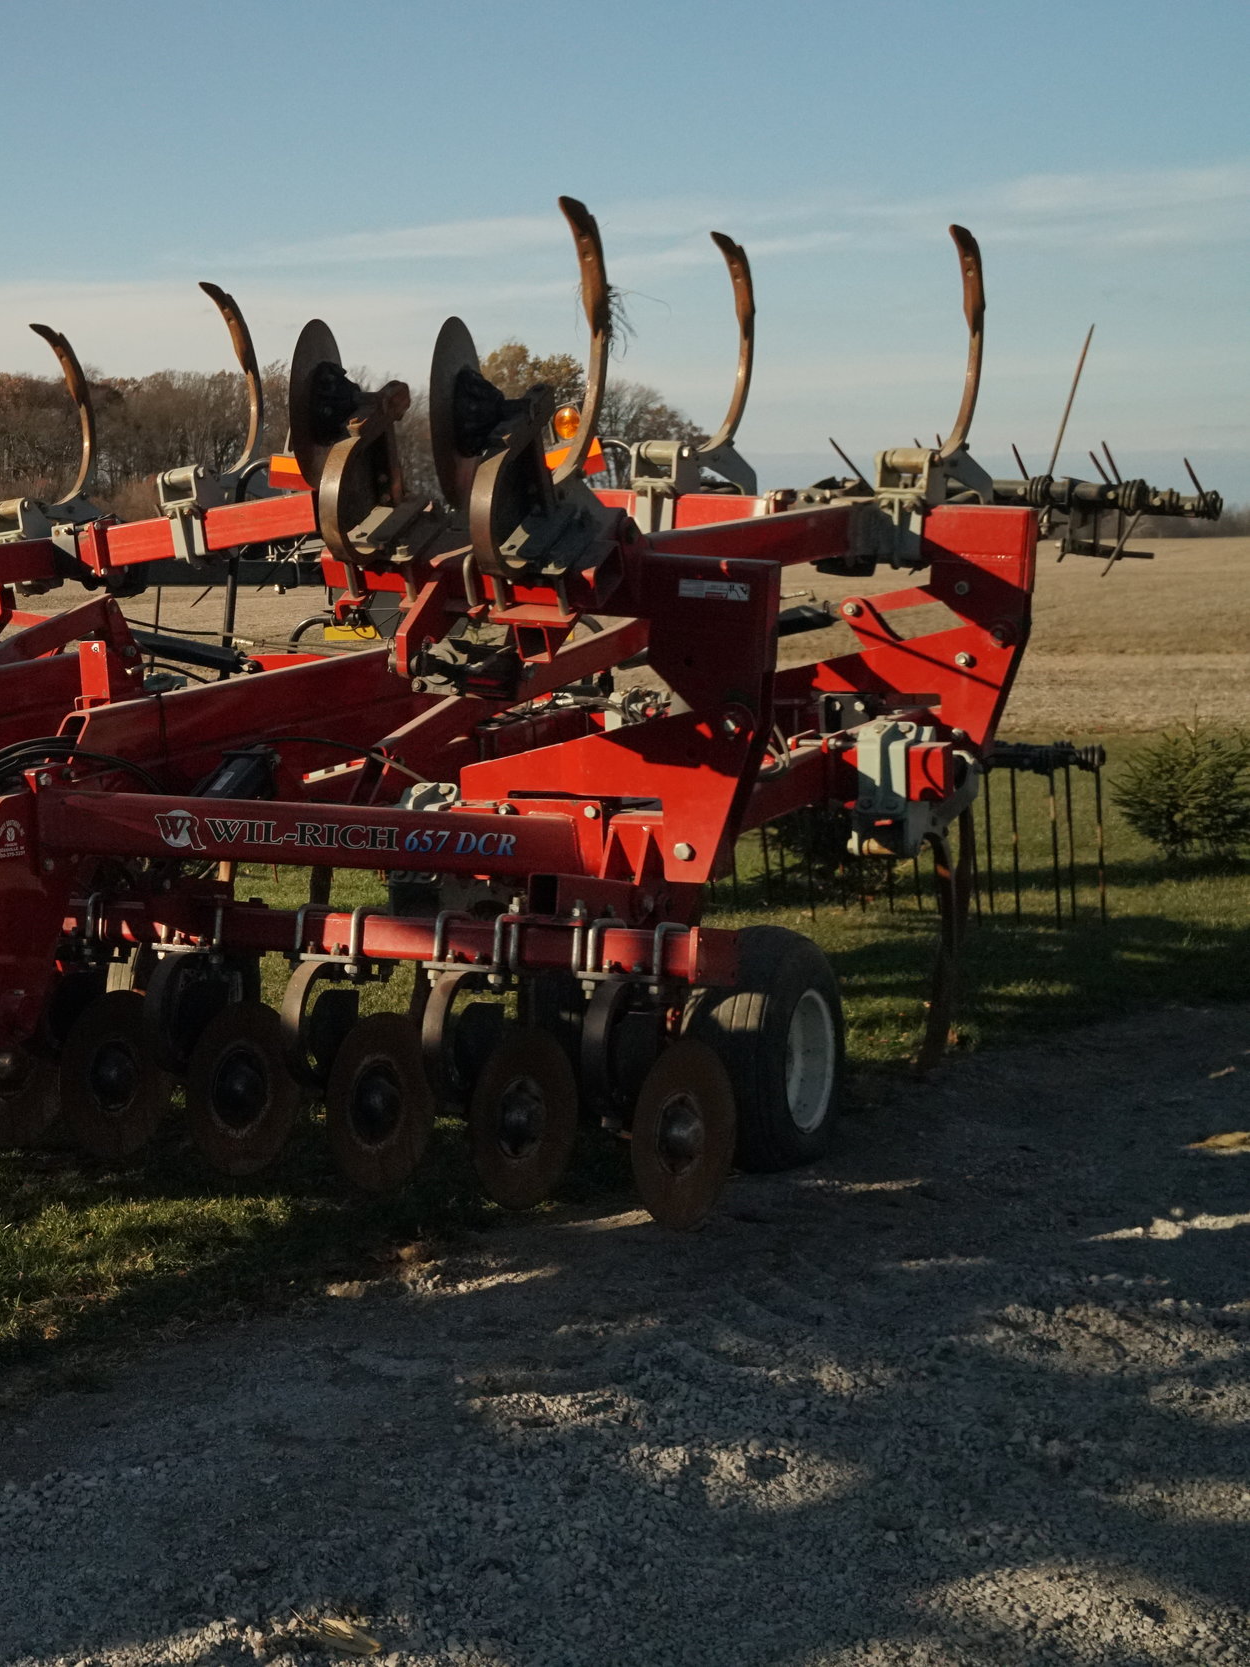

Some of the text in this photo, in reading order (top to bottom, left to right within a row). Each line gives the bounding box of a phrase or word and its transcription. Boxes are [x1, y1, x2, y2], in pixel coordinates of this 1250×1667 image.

[206, 818, 399, 851] WIL-RICH
[404, 829, 450, 853] 657
[454, 832, 517, 856] DCR
